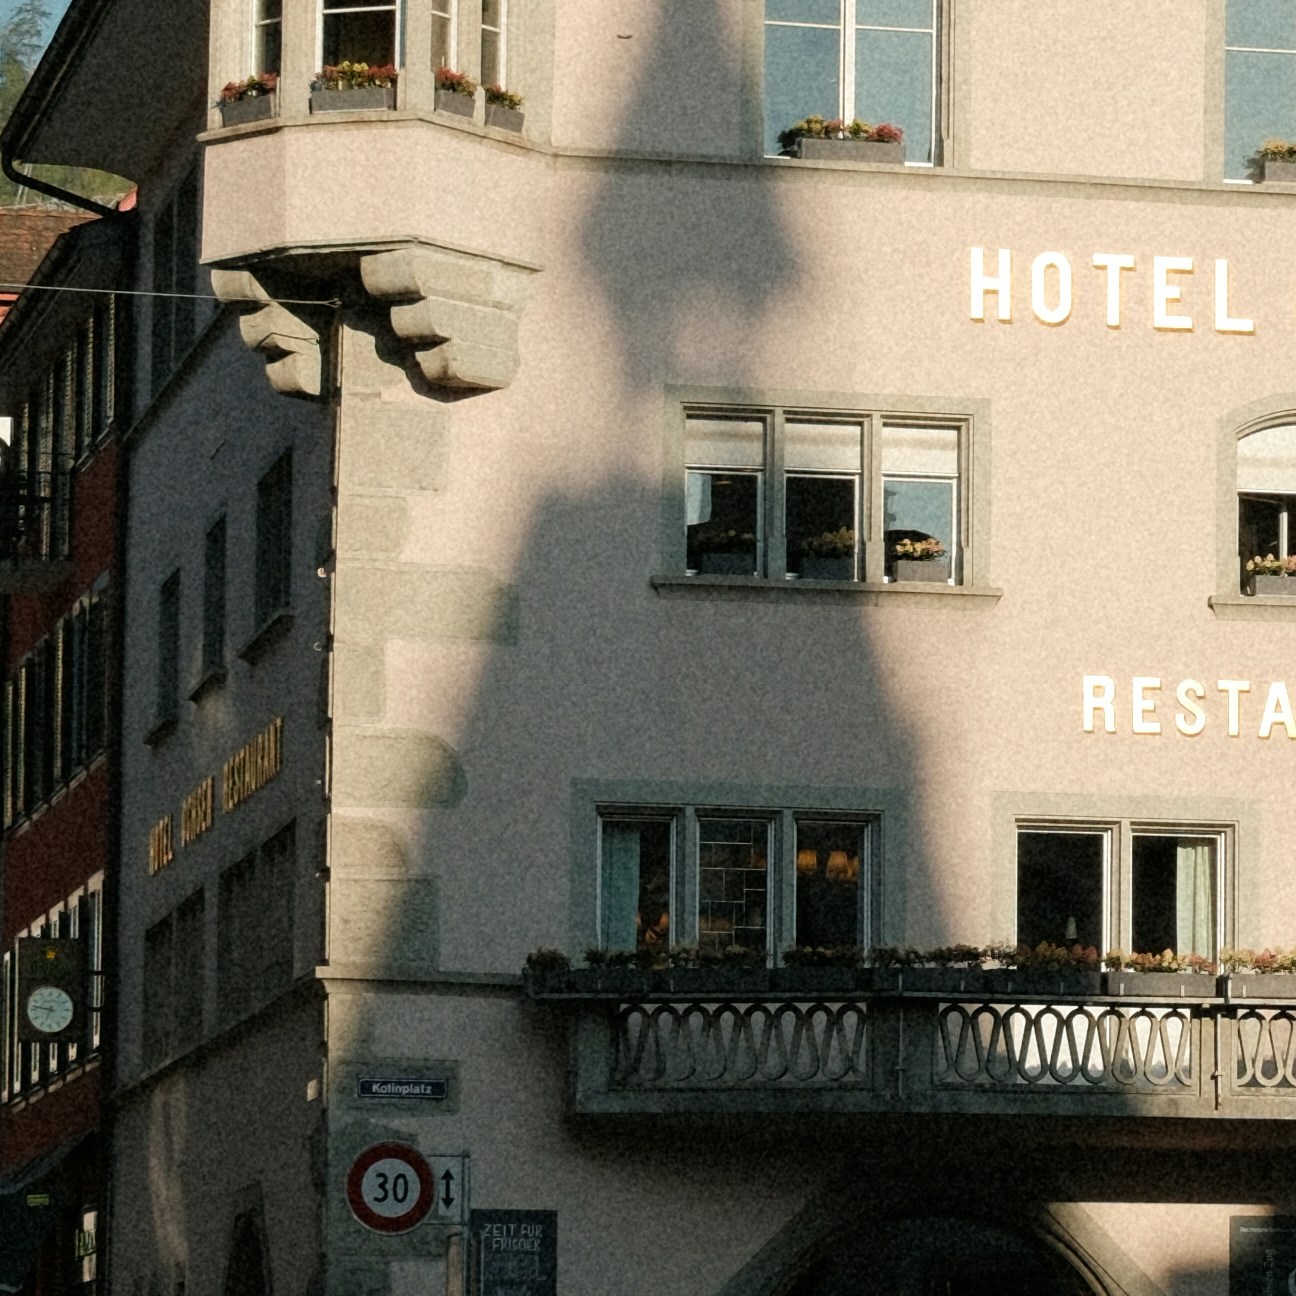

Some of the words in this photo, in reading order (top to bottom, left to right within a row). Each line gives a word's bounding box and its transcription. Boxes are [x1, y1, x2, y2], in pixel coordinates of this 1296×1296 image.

[969, 247, 1255, 333] HOTEL
[149, 814, 174, 876] HOTEL
[222, 716, 284, 814] RESTAURANT
[372, 1082, 433, 1095] Kolinplatz
[373, 1173, 409, 1203] 30
[482, 1223, 517, 1237] ZEIT
